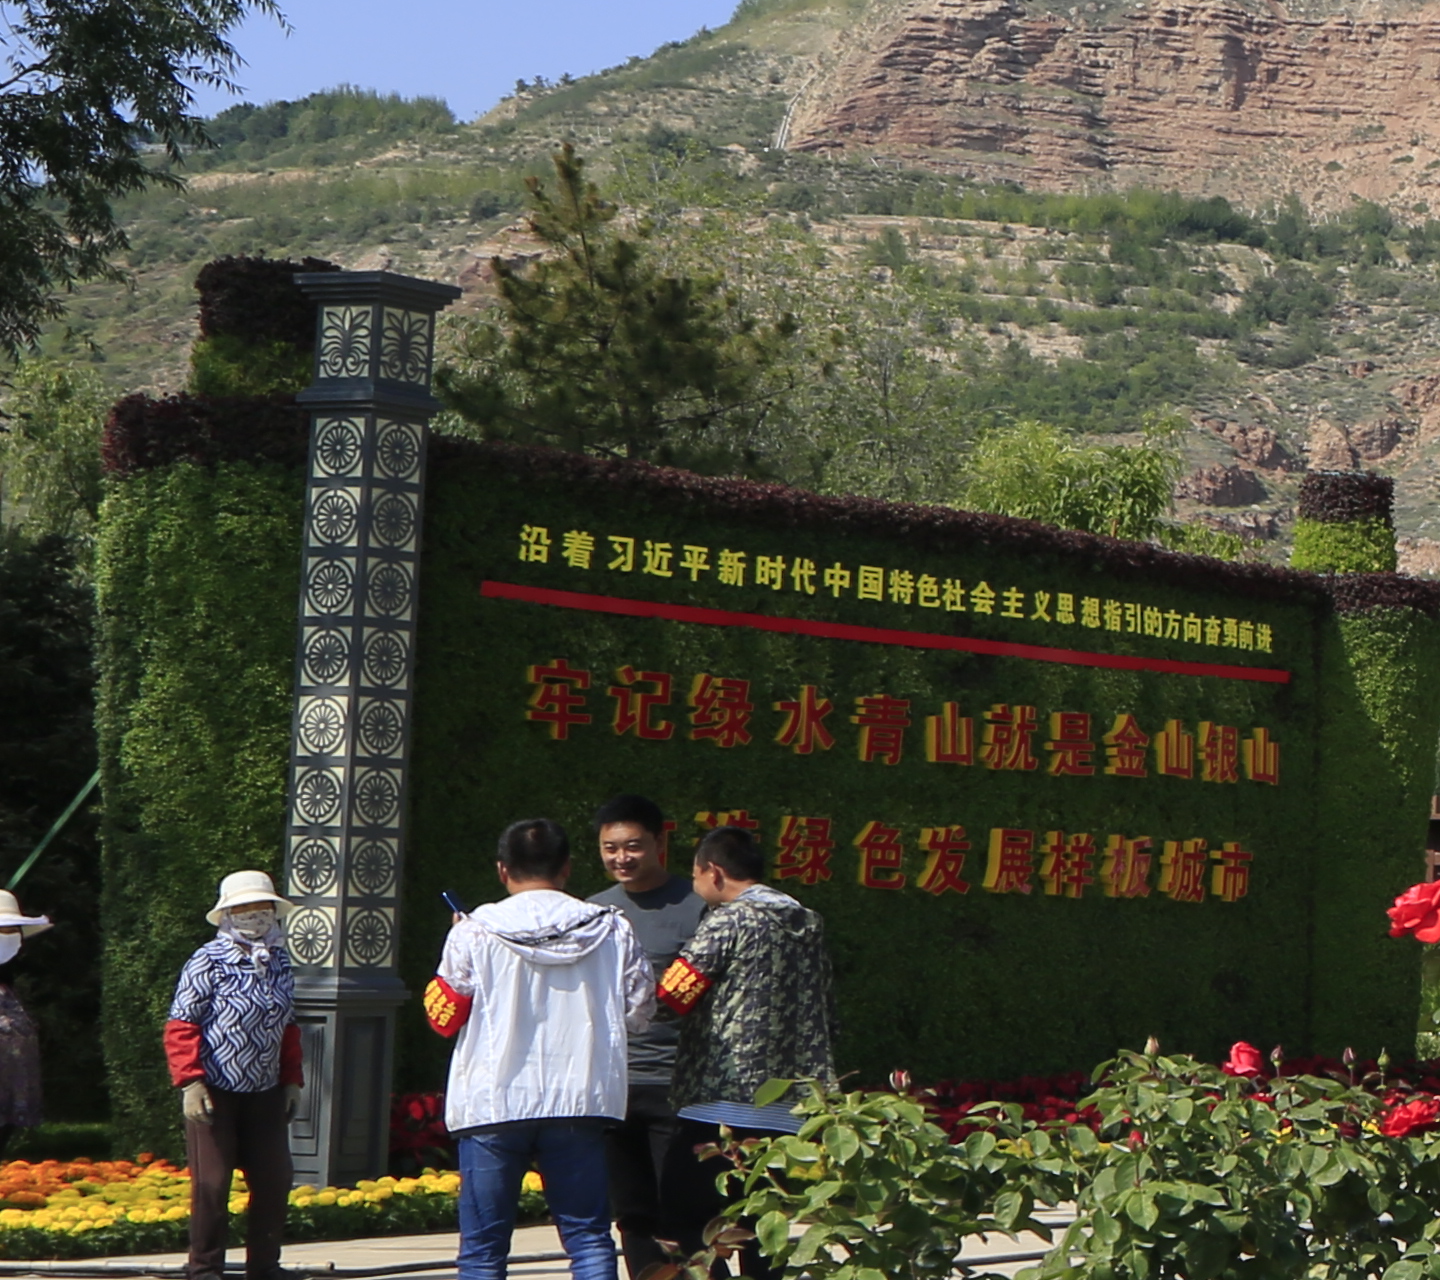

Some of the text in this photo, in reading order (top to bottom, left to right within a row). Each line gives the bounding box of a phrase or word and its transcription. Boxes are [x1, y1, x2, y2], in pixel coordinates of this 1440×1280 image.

[519, 524, 1273, 654] 沿着习近平新时代中国特色社会主义思想指引的方向奋勇前进
[525, 658, 1280, 786] 牢记绿水青山就是金山银山
[604, 809, 1253, 902] 绿色发展样板城市
